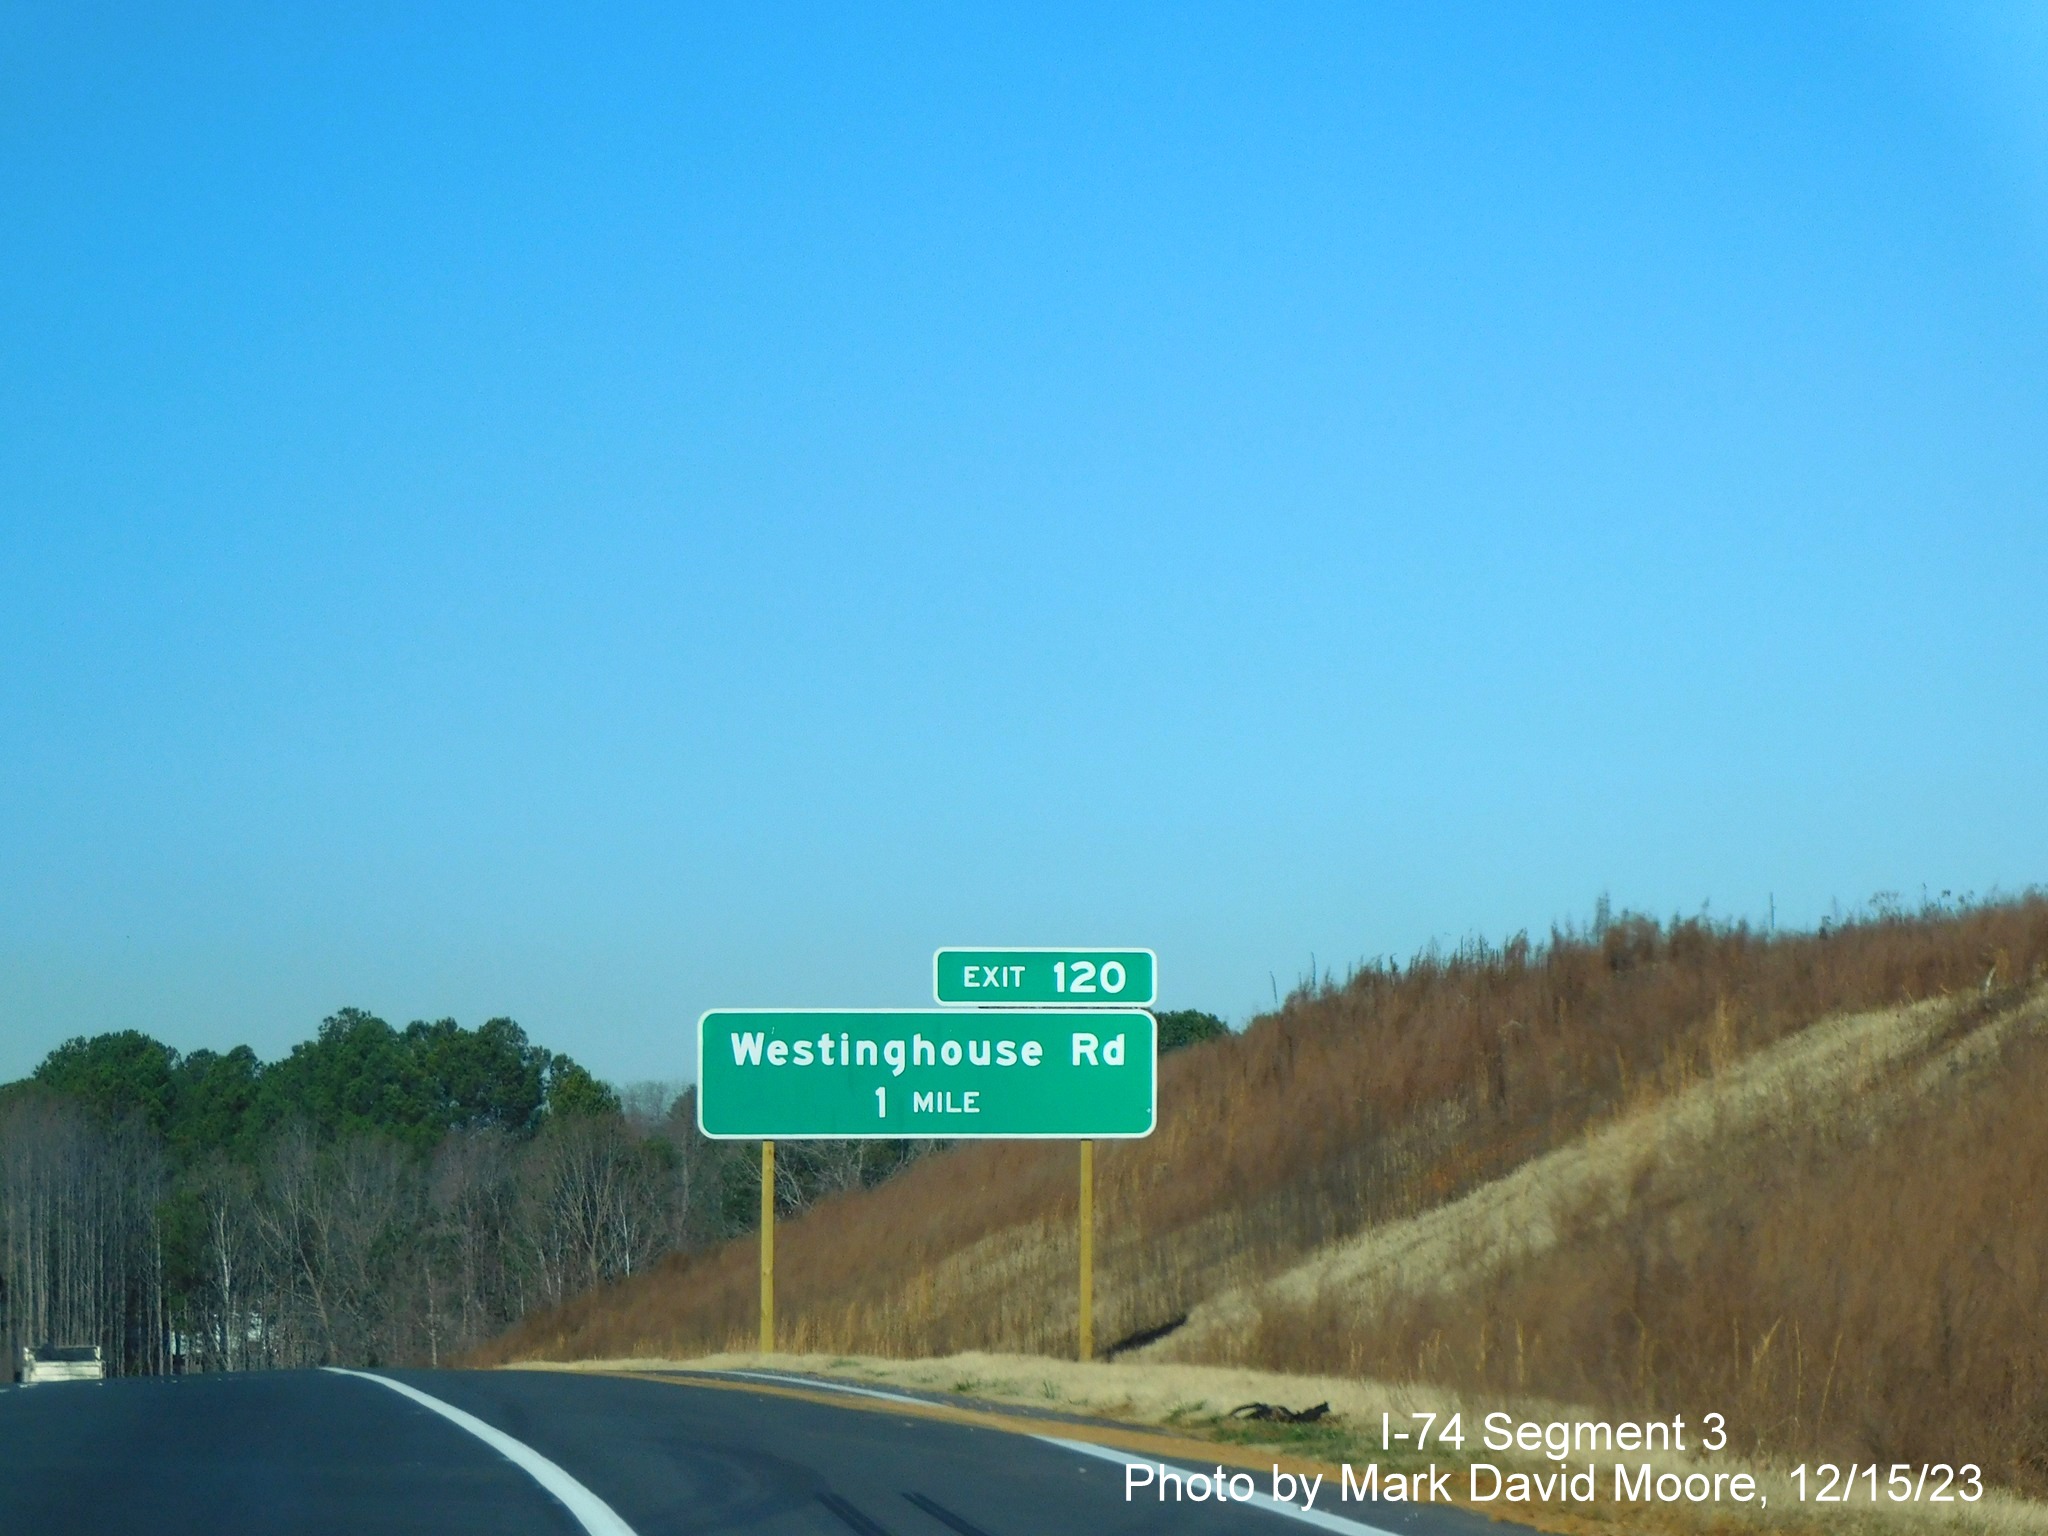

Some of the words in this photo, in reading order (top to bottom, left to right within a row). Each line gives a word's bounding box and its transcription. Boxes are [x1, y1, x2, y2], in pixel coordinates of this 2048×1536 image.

[965, 966, 1025, 987] EXIT
[1054, 961, 1125, 993] 120
[732, 1033, 1042, 1076] Westinghouse
[1073, 1033, 1124, 1065] Rd
[876, 1087, 885, 1117] 1
[914, 1092, 979, 1112] MILE
